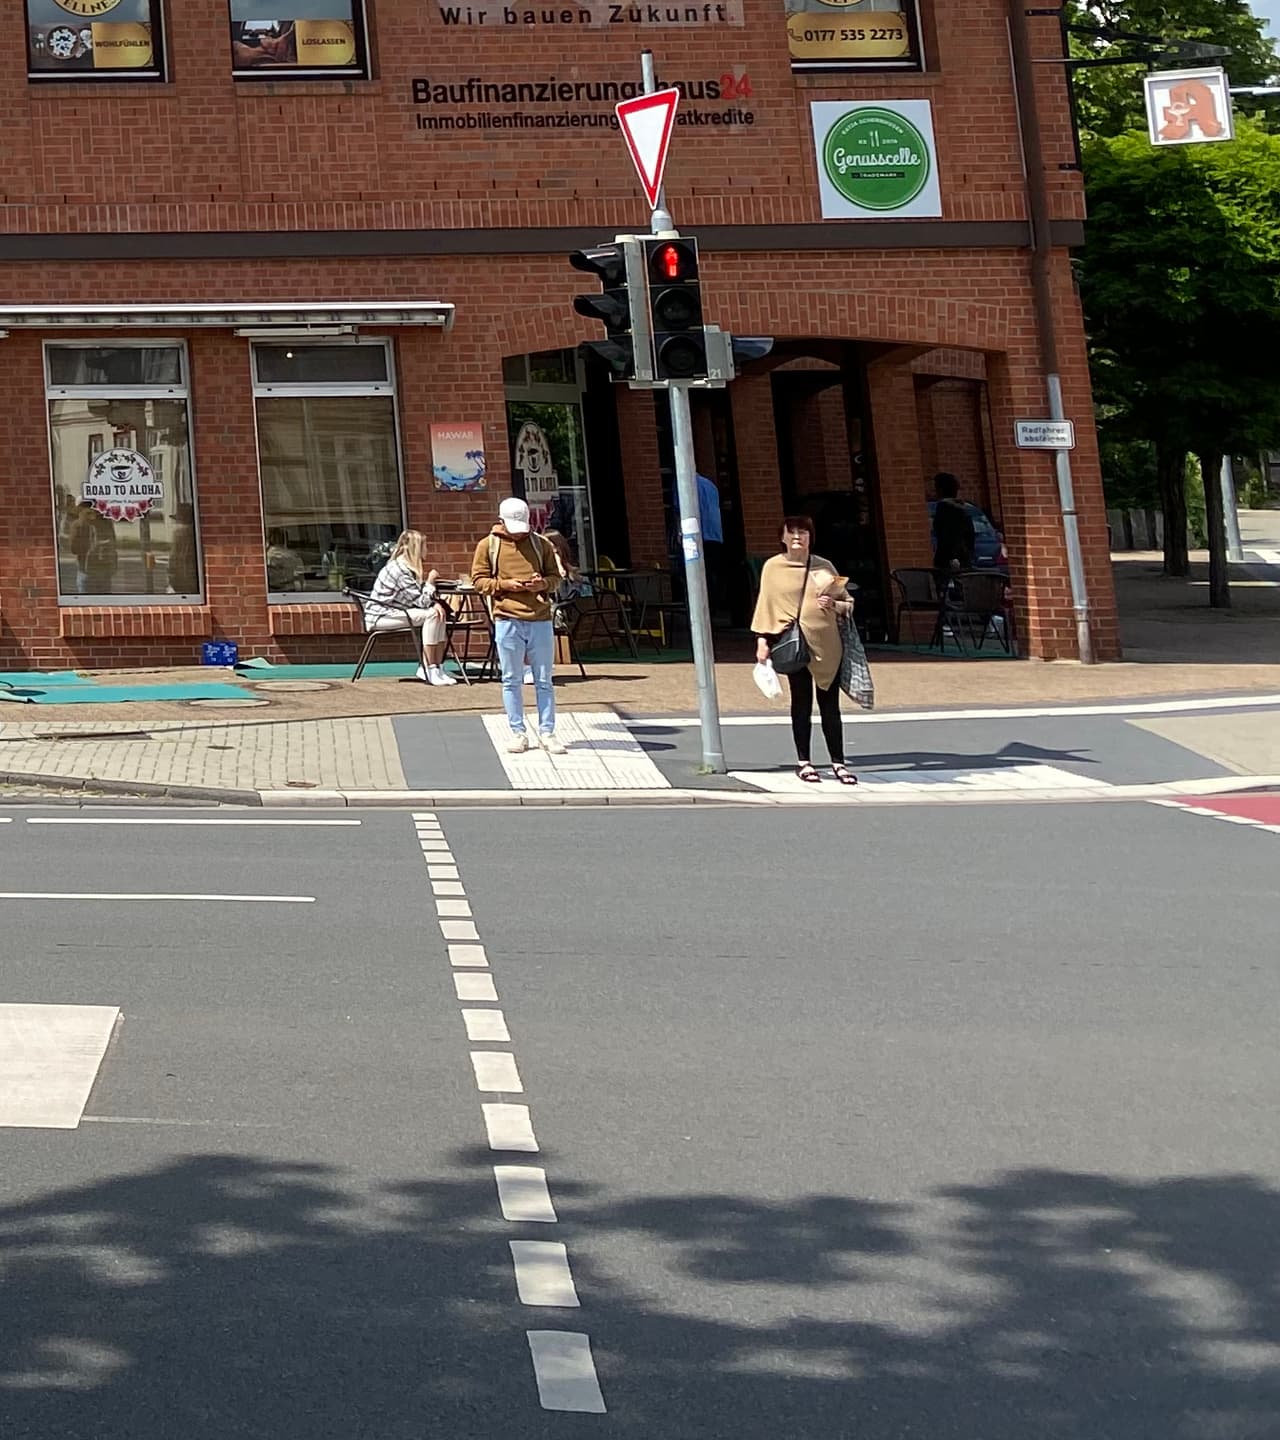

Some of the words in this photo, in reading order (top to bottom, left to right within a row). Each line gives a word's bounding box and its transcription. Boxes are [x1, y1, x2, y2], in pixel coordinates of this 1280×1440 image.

[440, 7, 487, 25] Wir
[504, 6, 592, 25] bauen
[804, 29, 835, 41] 0177
[840, 29, 865, 41] 535
[870, 28, 903, 40] 2273
[95, 40, 149, 48] WOHLFÜHLEN
[302, 38, 346, 46] LOSLASSEN
[416, 111, 620, 130] Immobilienfinanzierung
[833, 147, 921, 175] Genusscelle
[1024, 435, 1066, 444] absteigen
[86, 485, 111, 496] ROAD
[114, 485, 127, 496] TO
[129, 484, 161, 496] ALOHA
